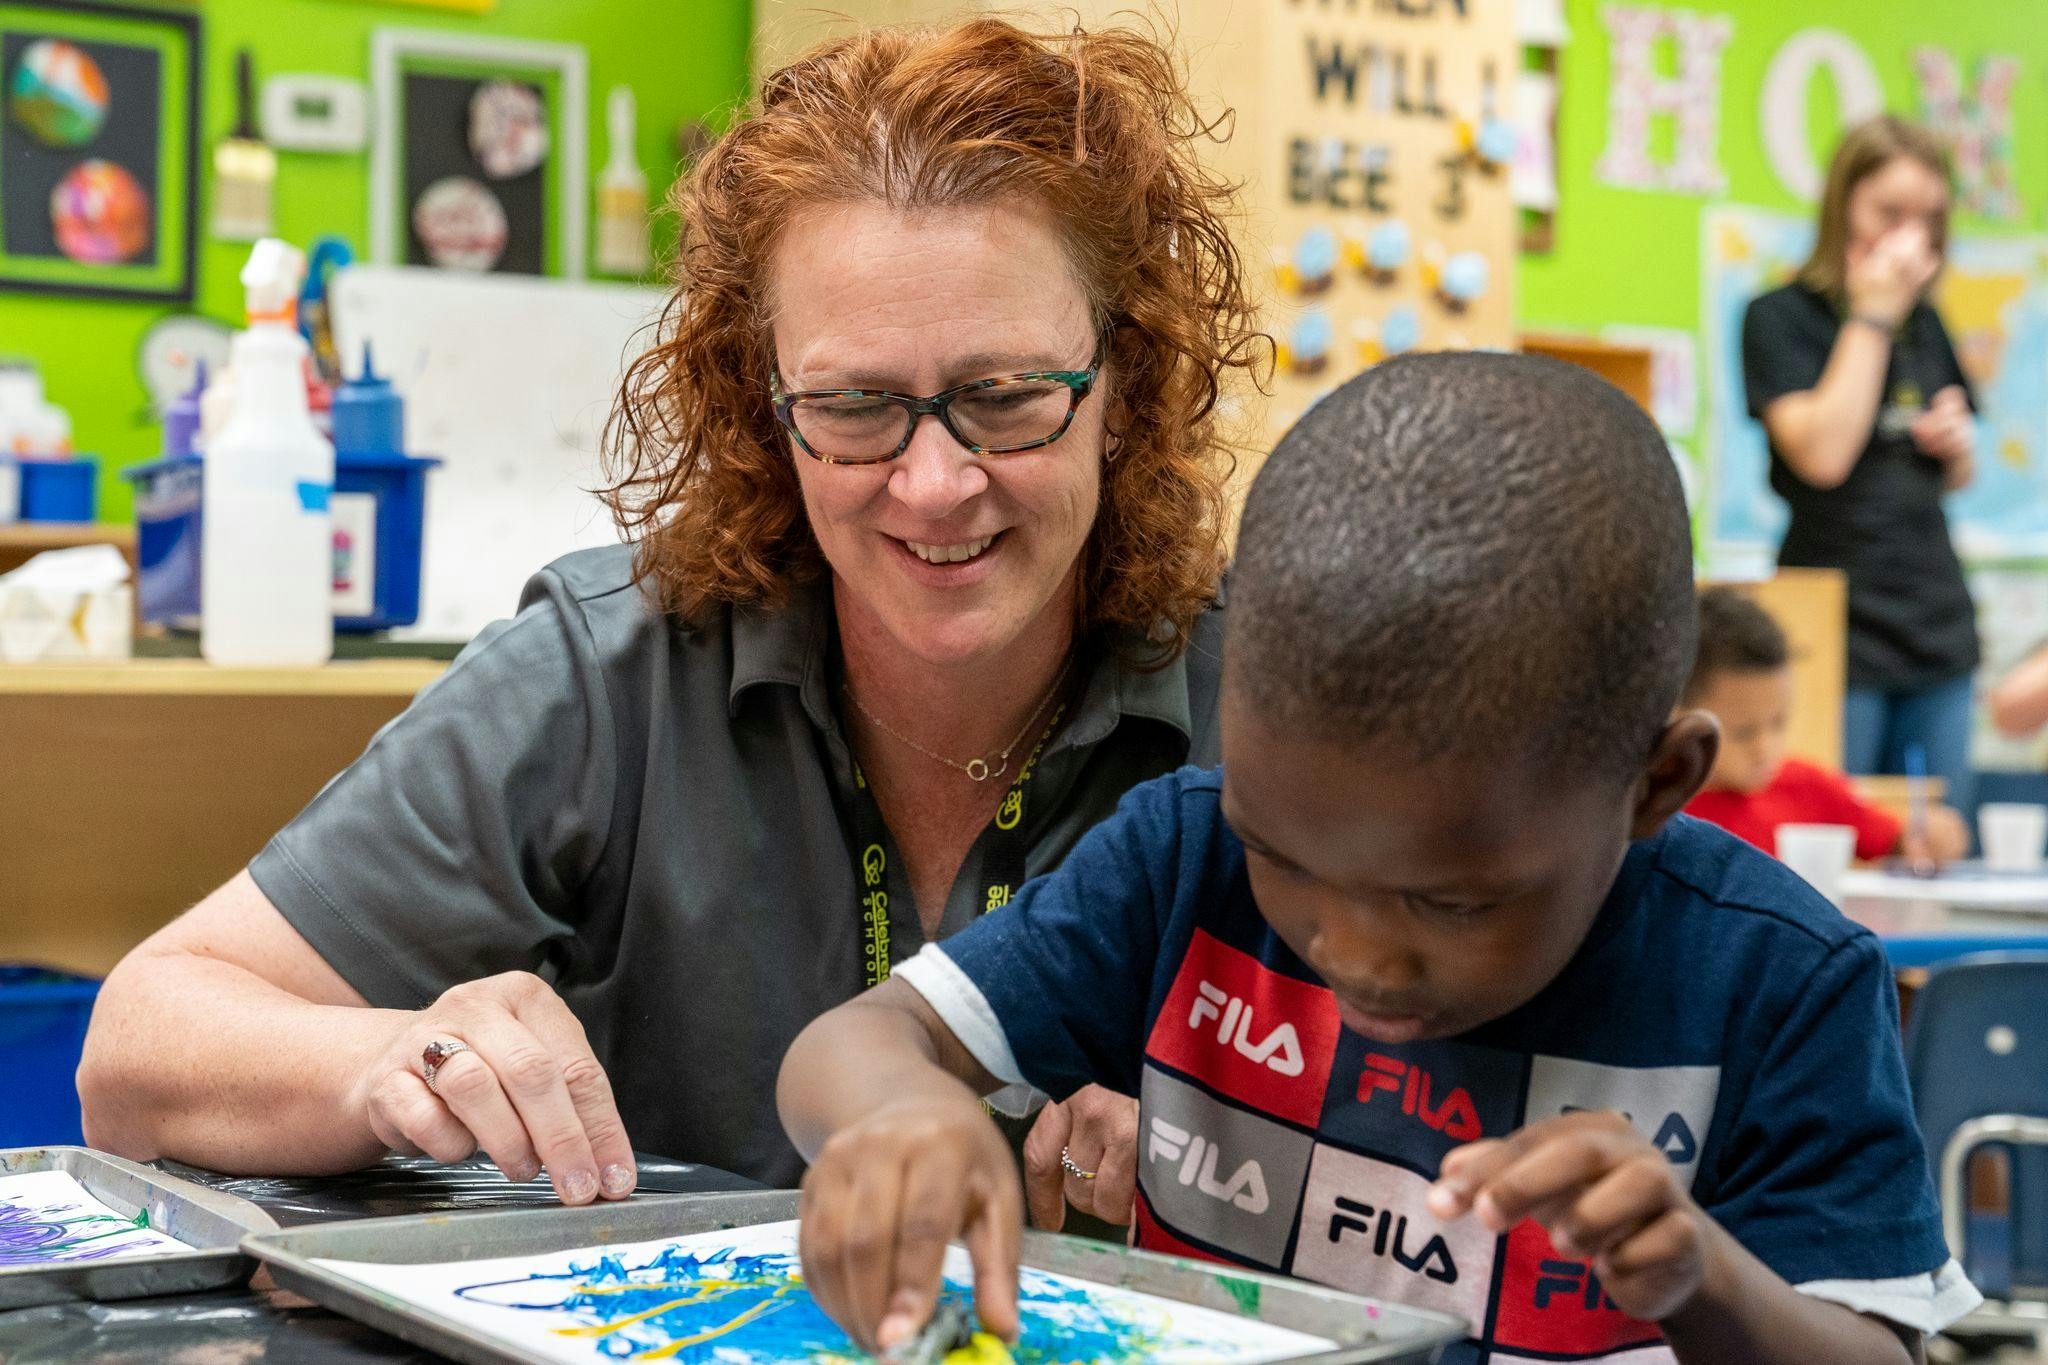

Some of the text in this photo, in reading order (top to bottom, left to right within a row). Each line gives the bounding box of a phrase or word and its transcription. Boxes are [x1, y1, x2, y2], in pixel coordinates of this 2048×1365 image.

[1303, 37, 1447, 119] WILL
[1289, 137, 1389, 212] BEE
[863, 898, 877, 986] SCHOOL
[1188, 979, 1304, 1077] FILA
[1357, 1052, 1482, 1141] FILA
[1150, 1117, 1269, 1214] FILA
[1328, 1196, 1458, 1284] FILA
[1534, 1259, 1620, 1310] FI
